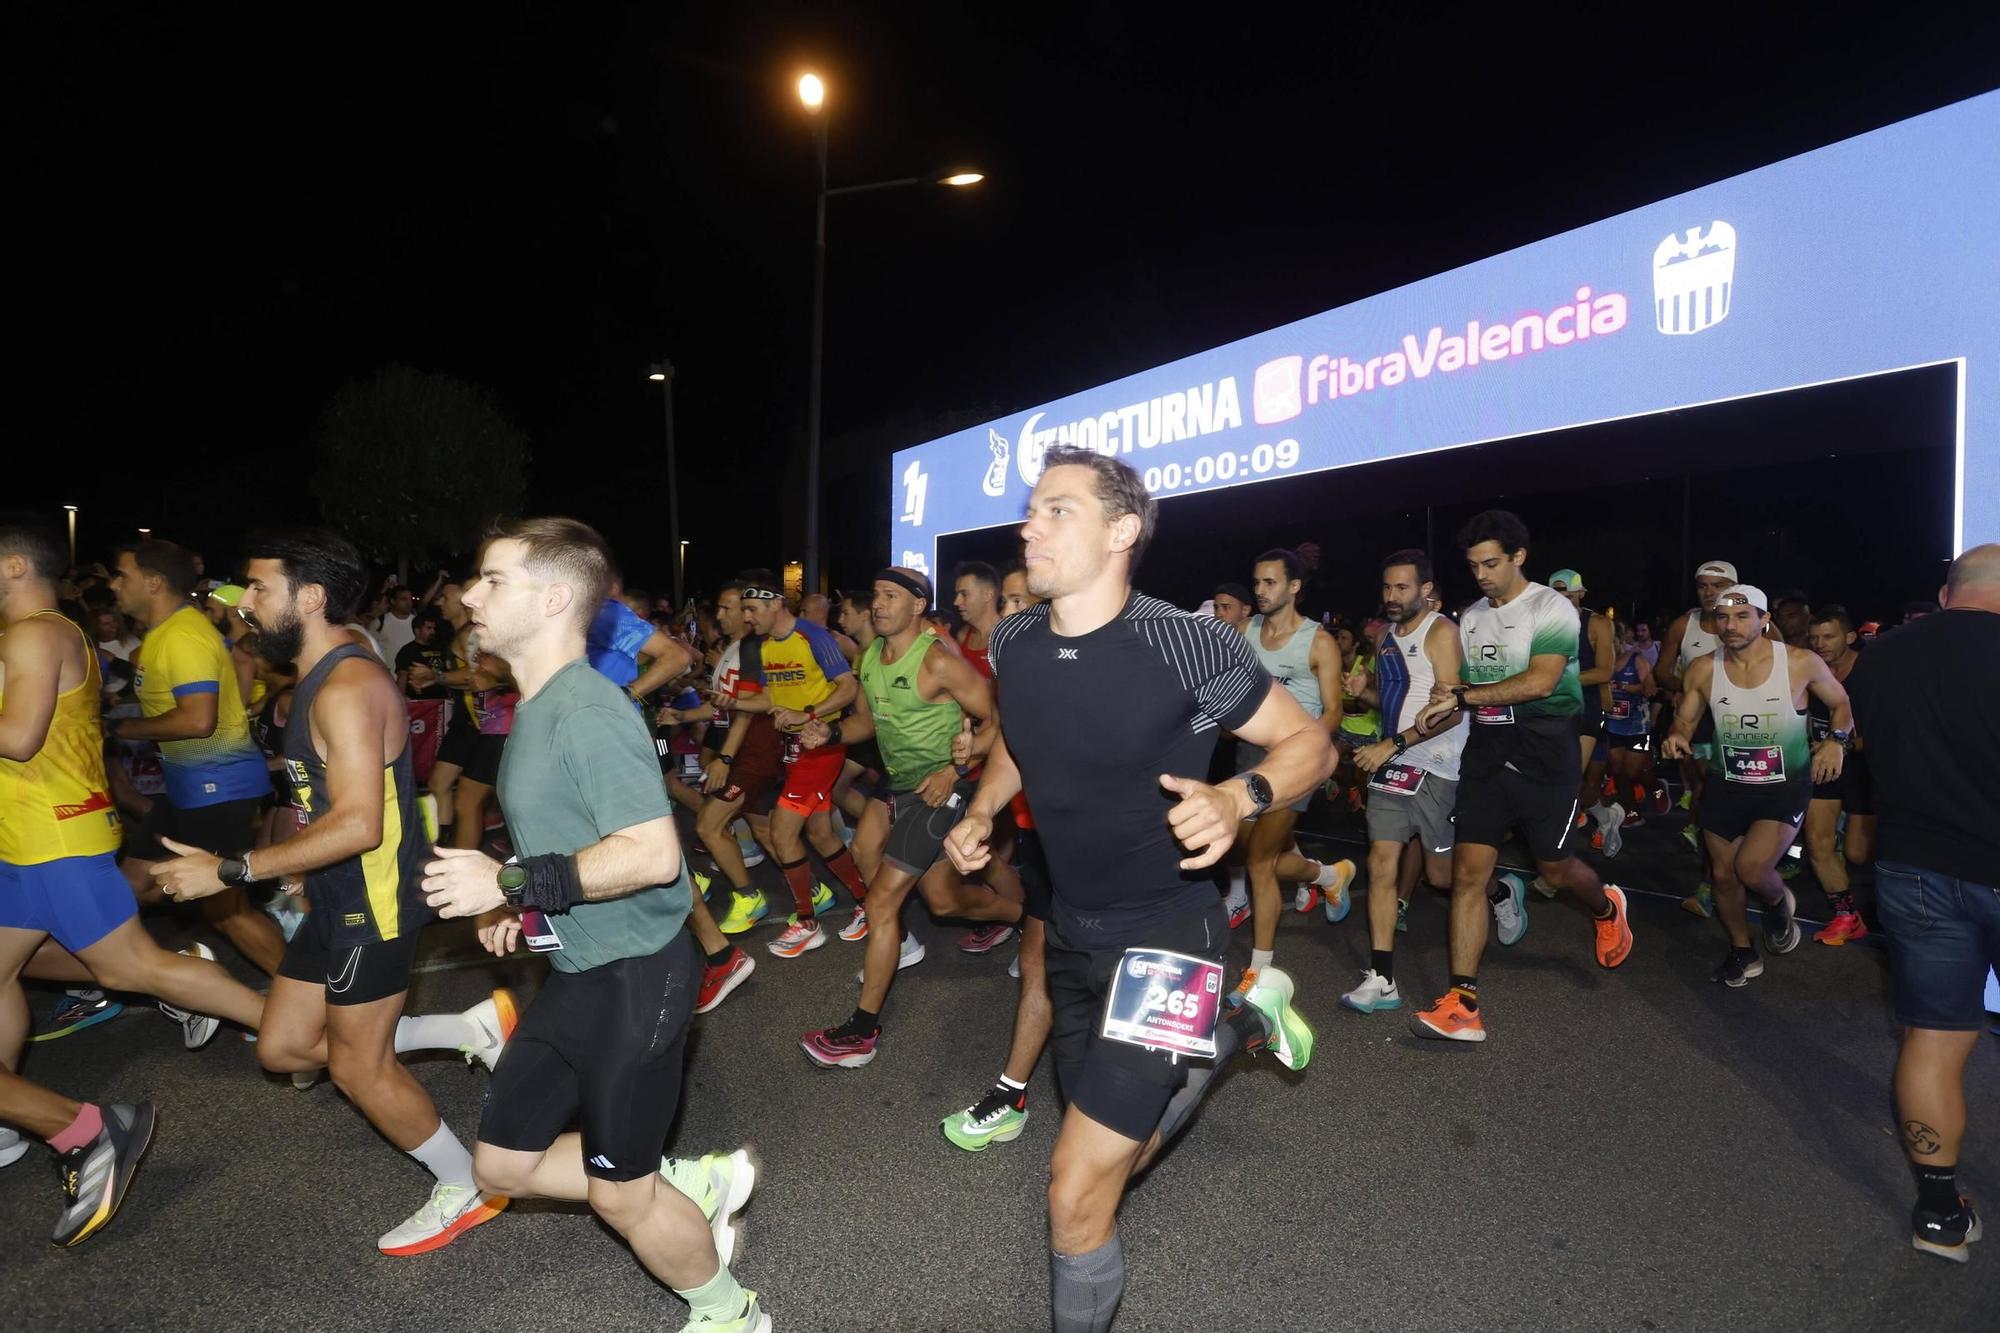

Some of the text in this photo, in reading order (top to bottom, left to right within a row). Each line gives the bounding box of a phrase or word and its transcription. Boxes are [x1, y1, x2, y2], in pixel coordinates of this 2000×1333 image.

[1144, 438, 1299, 492] 00:00:09
[1385, 769, 1409, 782] 669
[1736, 760, 1768, 771] 448
[1147, 985, 1198, 1018] 265
